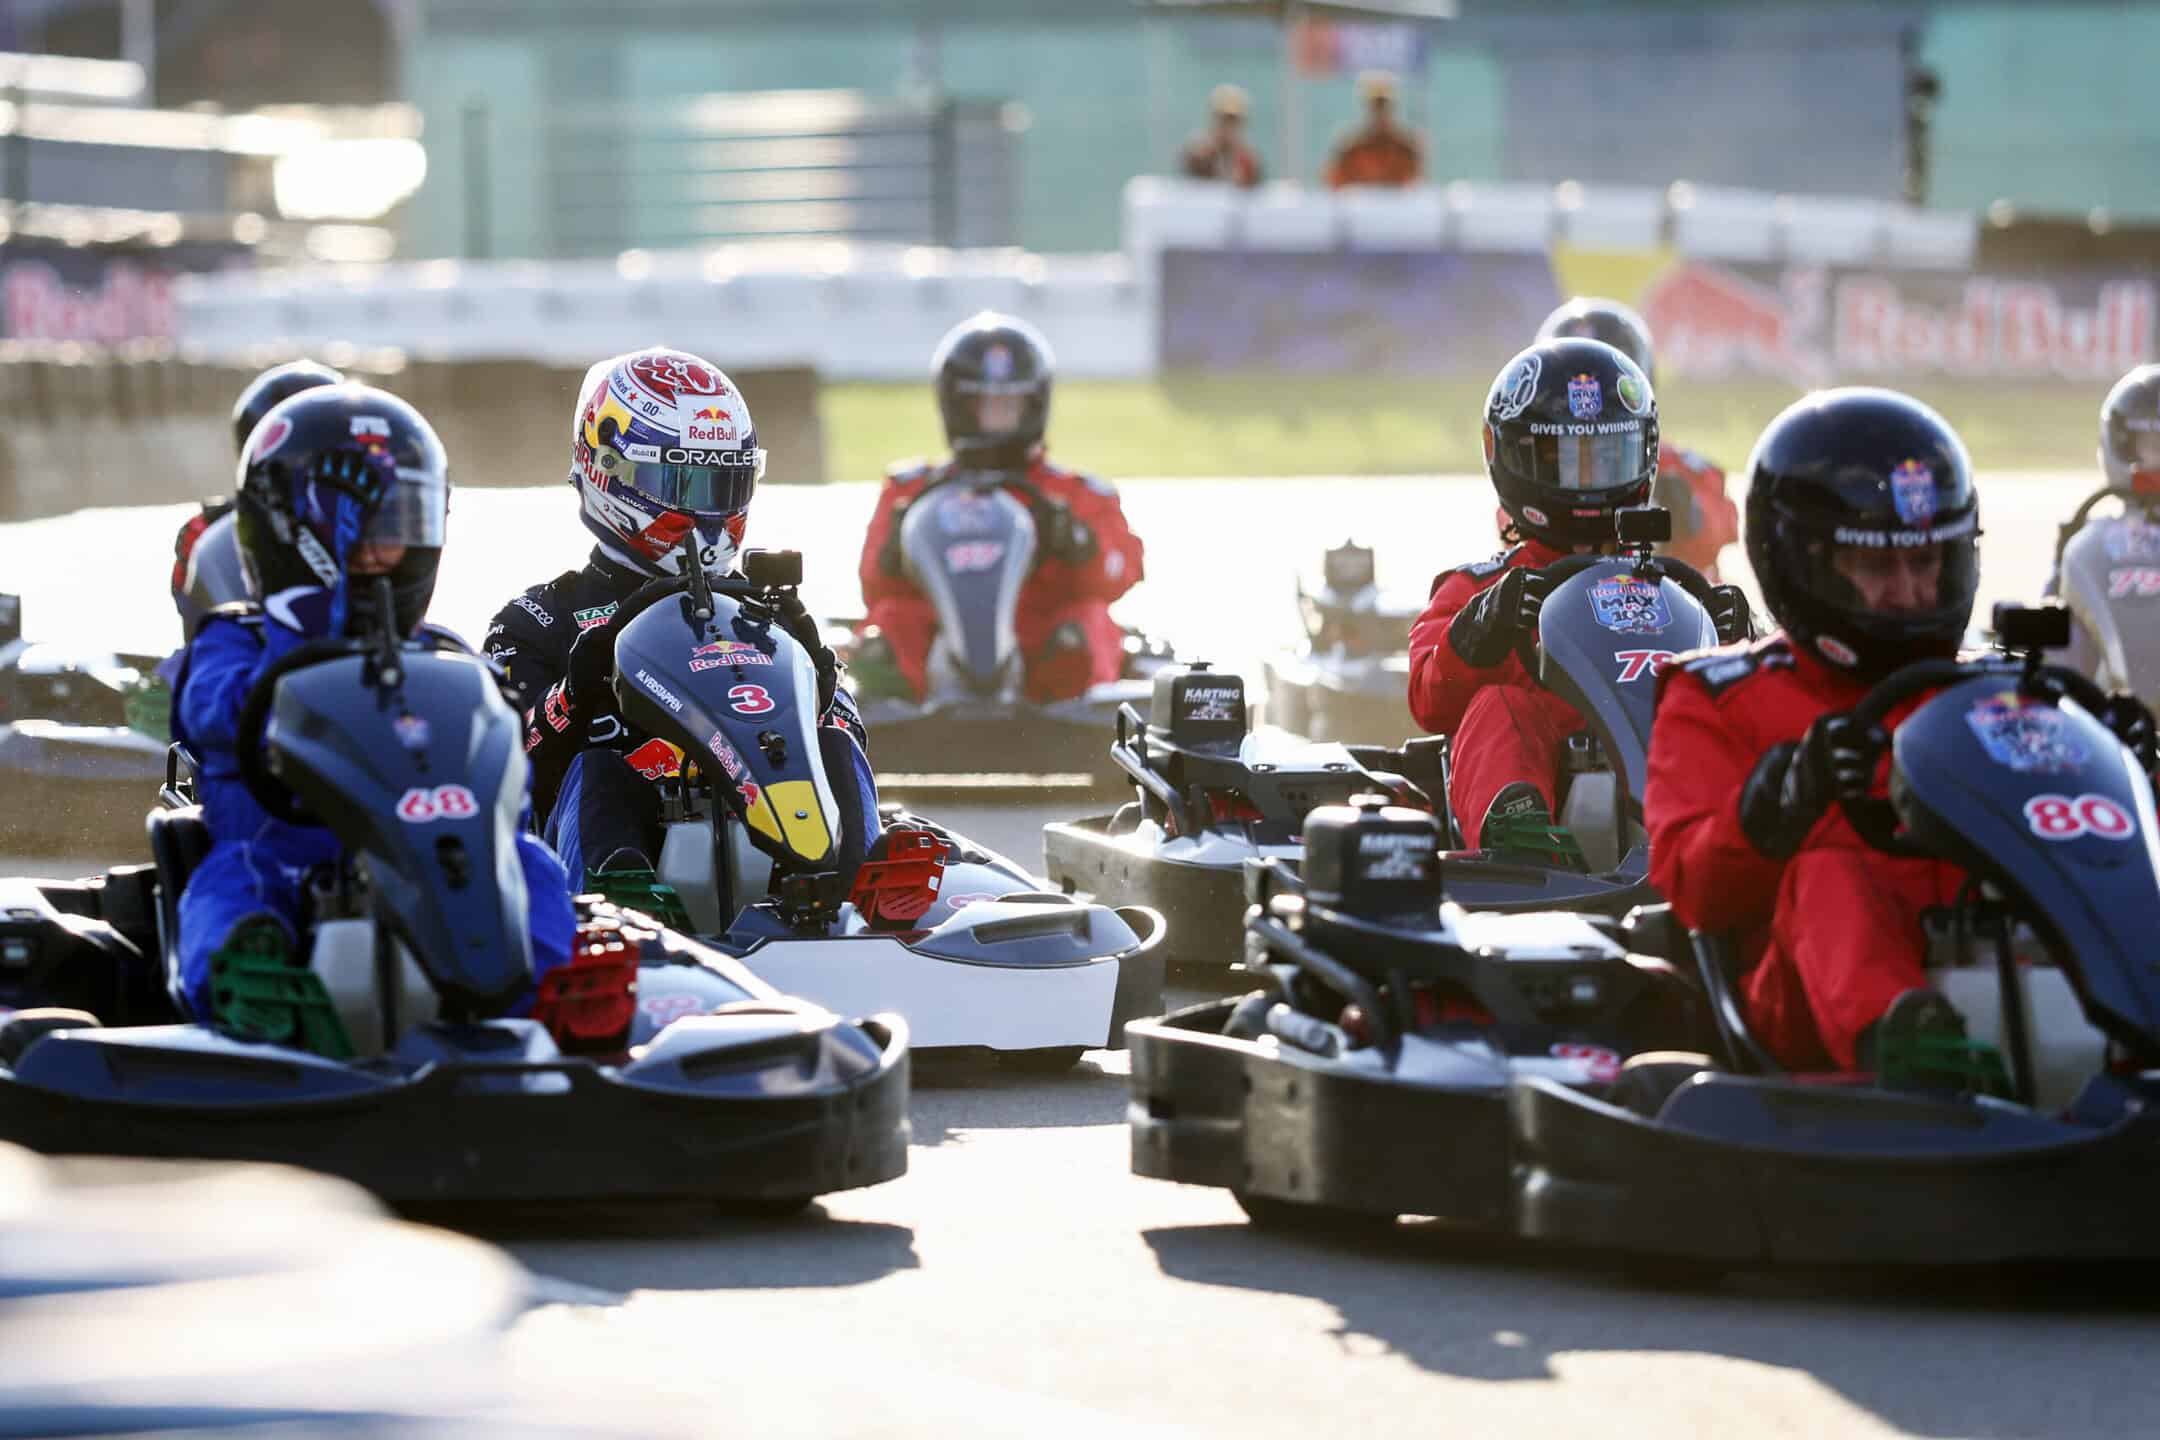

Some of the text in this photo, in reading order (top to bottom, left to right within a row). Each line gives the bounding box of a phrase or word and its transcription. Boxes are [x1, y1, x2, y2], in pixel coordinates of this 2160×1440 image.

[1530, 423, 1564, 435] GIVES
[1567, 423, 1595, 435] YOU
[665, 448, 757, 467] ORACLE
[1890, 530, 1927, 547] YOU
[580, 606, 617, 621] TAG
[727, 684, 776, 714] 3
[1184, 688, 1241, 700] KARTING
[396, 784, 479, 823] 68
[2023, 795, 2136, 840] 80
